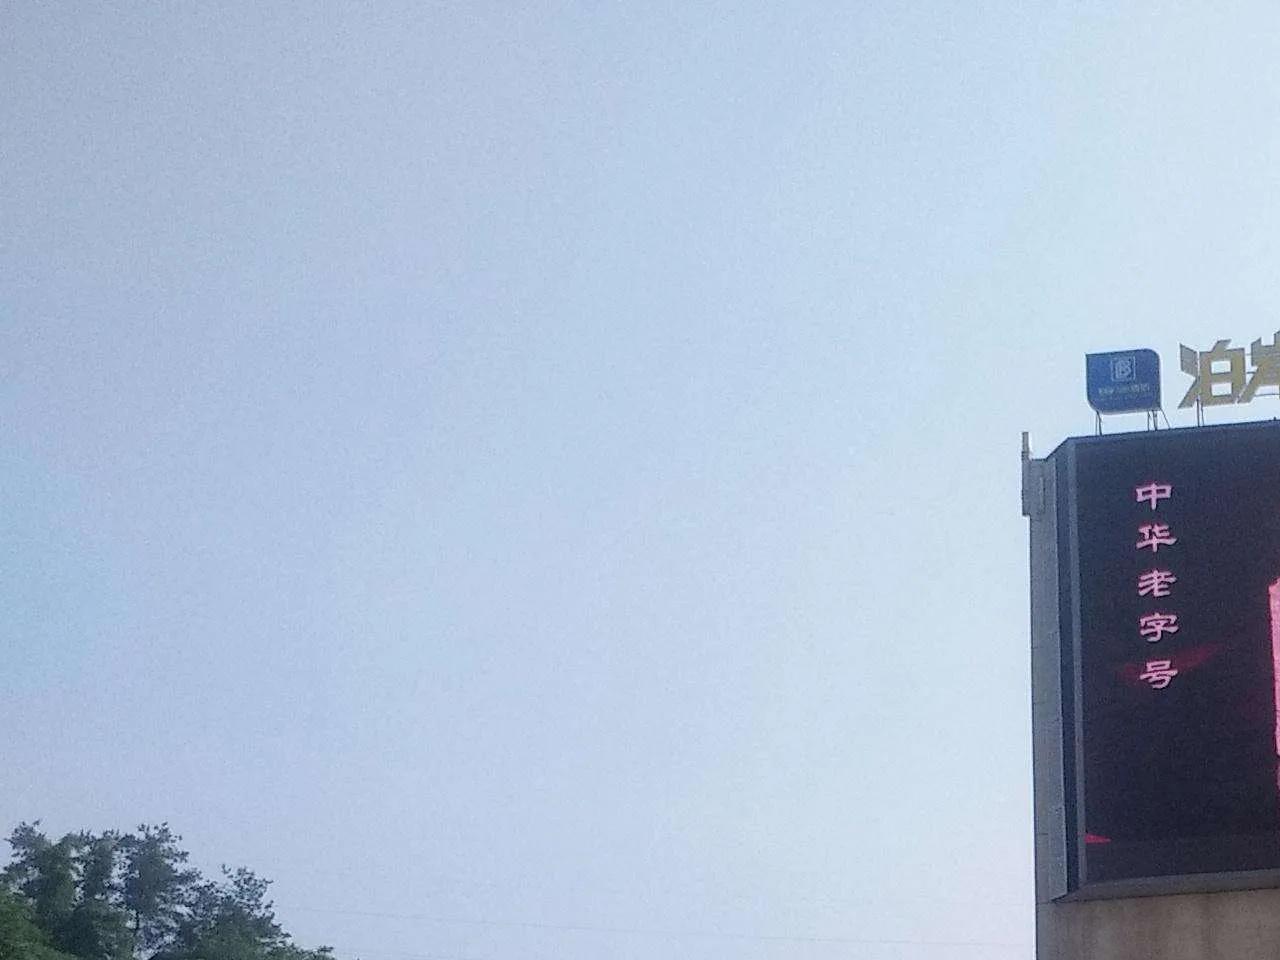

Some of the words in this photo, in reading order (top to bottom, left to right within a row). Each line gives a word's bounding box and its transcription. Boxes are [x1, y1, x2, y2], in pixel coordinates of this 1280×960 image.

[1135, 482, 1179, 690] 中华老字号
